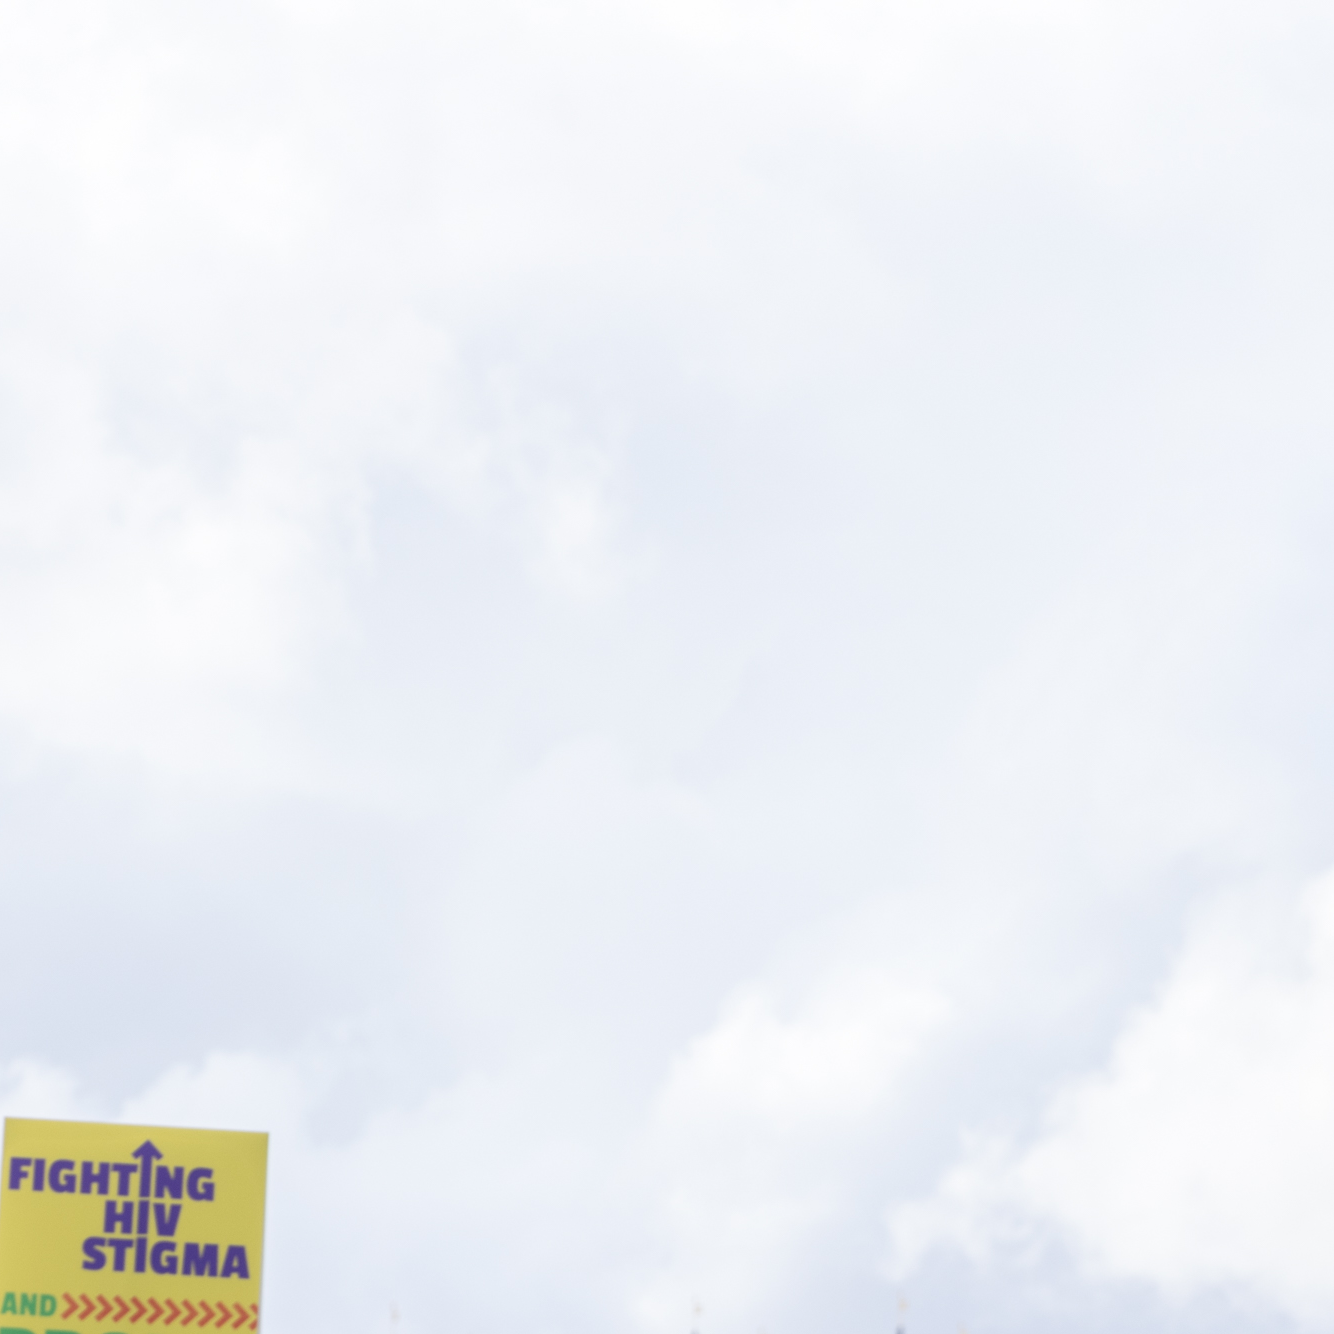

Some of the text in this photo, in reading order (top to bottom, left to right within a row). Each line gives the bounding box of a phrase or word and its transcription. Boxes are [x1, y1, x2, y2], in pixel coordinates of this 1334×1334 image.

[8, 1156, 216, 1202] FIGHTING
[103, 1200, 182, 1238] HIV
[82, 1236, 251, 1280] STIGMA
[0, 1292, 58, 1319] AND
